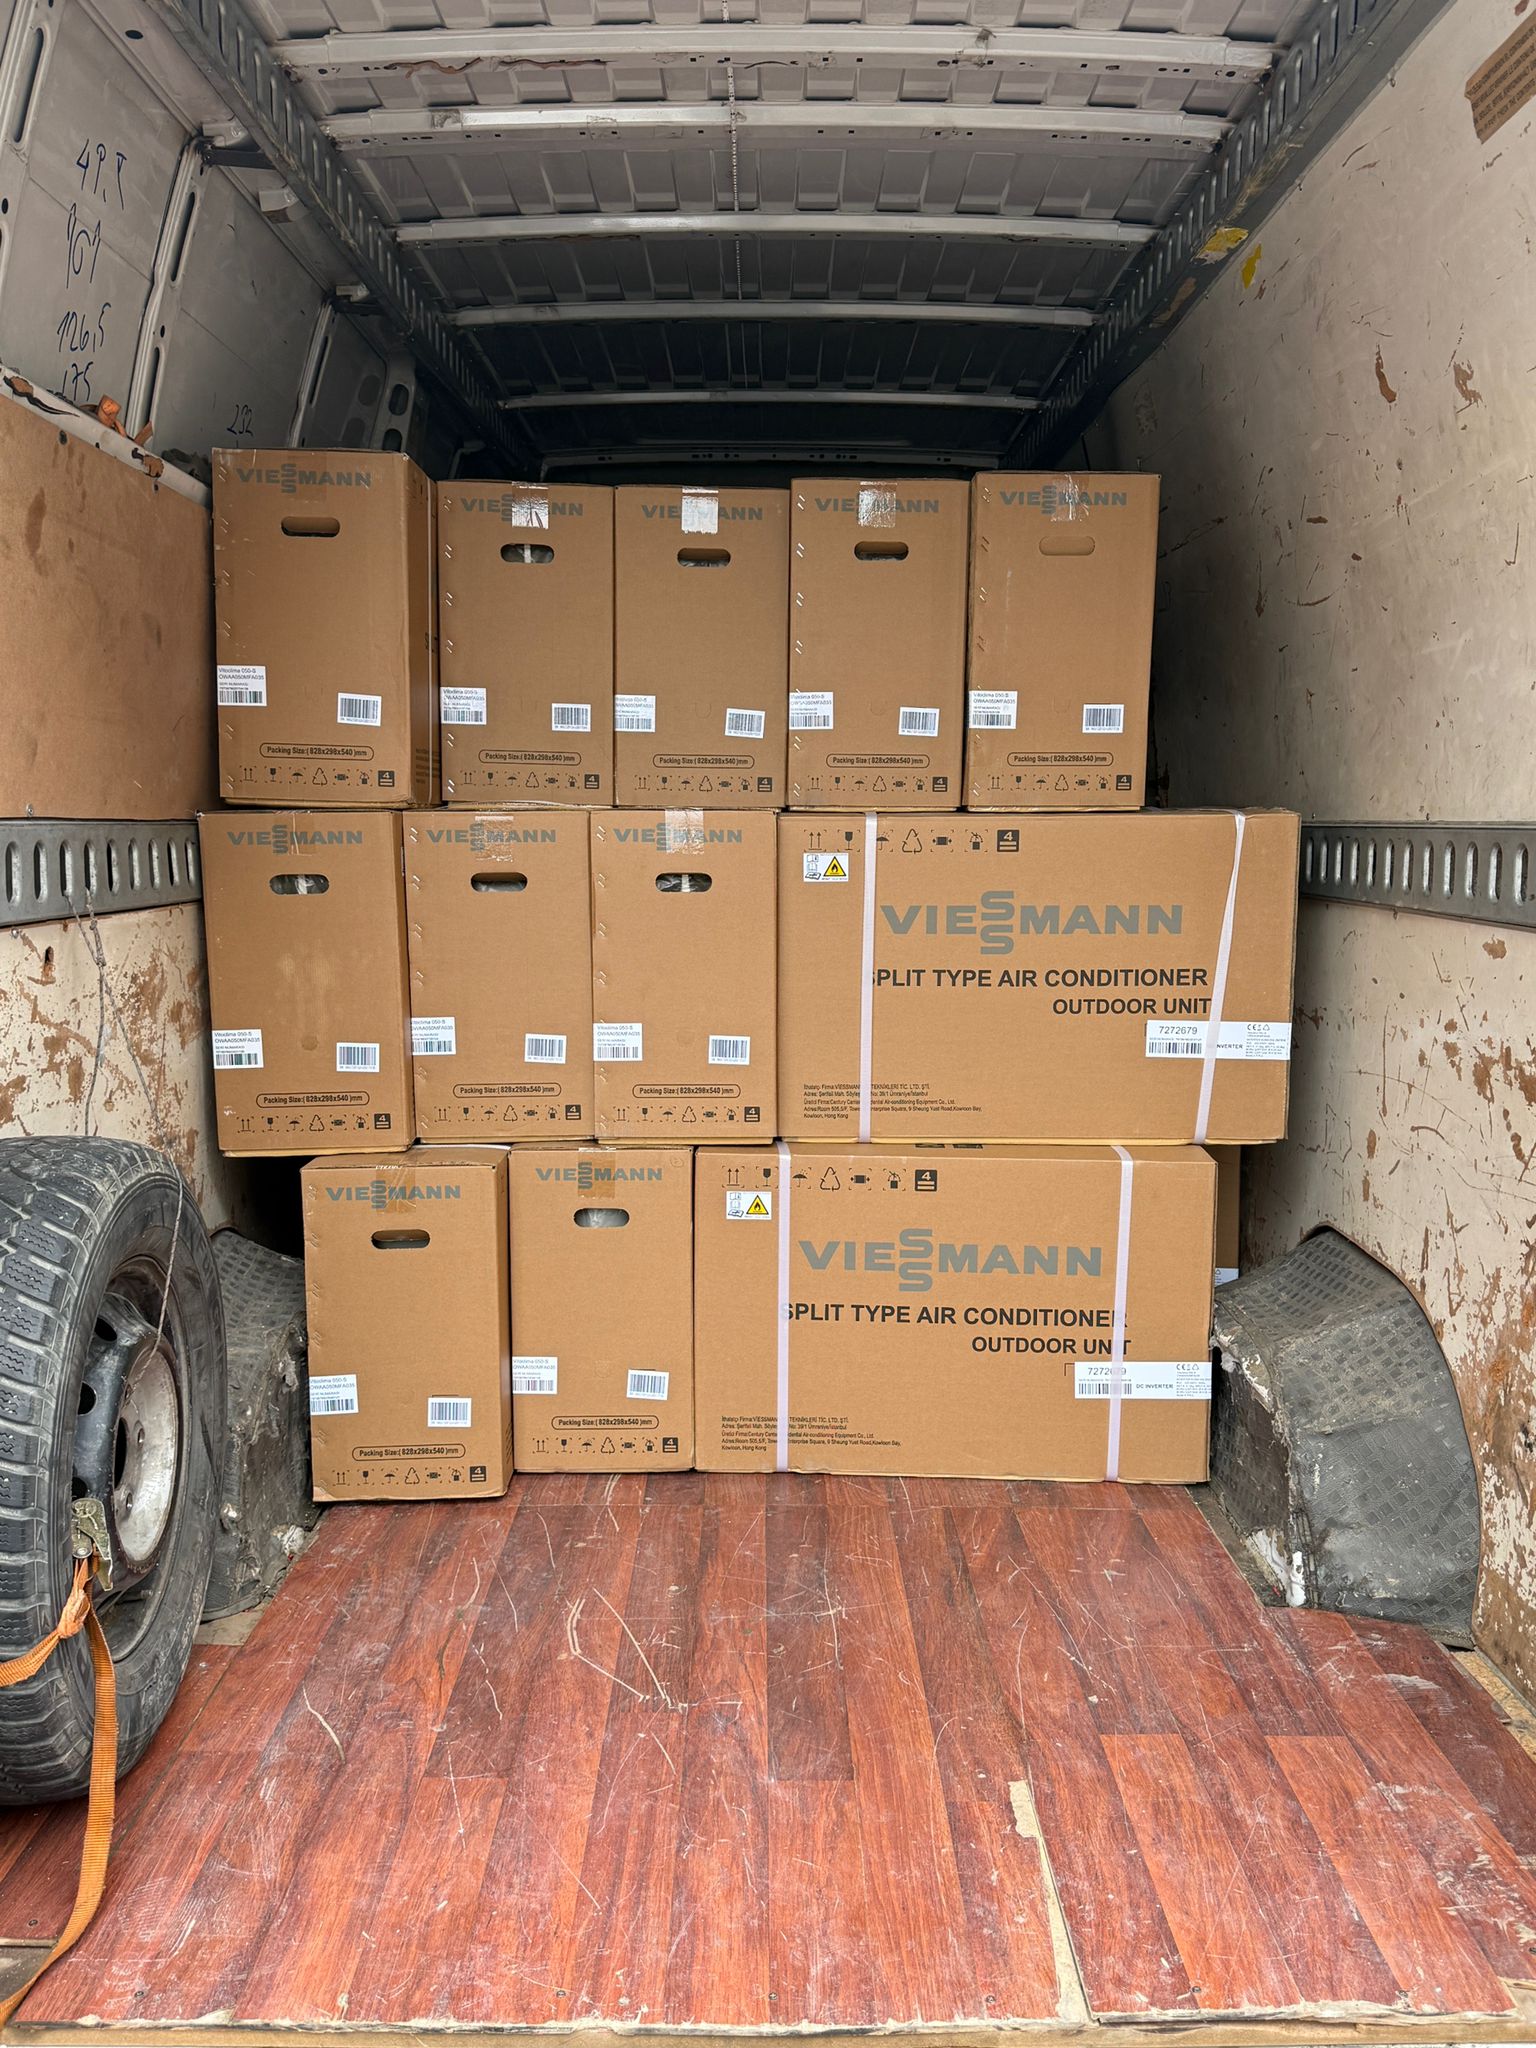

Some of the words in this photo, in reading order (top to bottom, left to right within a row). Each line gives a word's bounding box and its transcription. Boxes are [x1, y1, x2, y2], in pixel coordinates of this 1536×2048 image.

[236, 463, 372, 494] VIESSMANN
[461, 493, 584, 522] VIESSNN
[266, 746, 292, 756] Packing
[485, 752, 507, 761] Packing
[660, 756, 681, 765] Packing
[832, 756, 854, 765] Packing
[1014, 755, 1036, 764] Packing
[227, 824, 363, 855] VIESSMANN
[880, 890, 1183, 955] VIESSMANN
[872, 969, 926, 987] PLIT
[932, 969, 992, 987] TYPE
[998, 969, 1038, 987] AIR
[1044, 968, 1208, 987] CONDITIONER
[1052, 998, 1157, 1014] OUTDOOR
[1164, 998, 1212, 1014] UNIT
[1159, 1026, 1198, 1035] 7272679
[460, 1086, 483, 1095] Packing
[640, 1087, 662, 1095] Packing
[264, 1096, 288, 1104] Packing
[536, 1161, 662, 1190] VIESSMANN
[326, 1180, 461, 1209] VIESSMANN
[798, 1228, 1102, 1292] VIESSMANN
[851, 1304, 911, 1323] TYPE
[916, 1306, 956, 1324] AIR
[972, 1336, 1077, 1354] OUTDOOR
[1083, 1338, 1132, 1356] UNT
[558, 1419, 582, 1427] Packing
[359, 1449, 384, 1457] Packing
